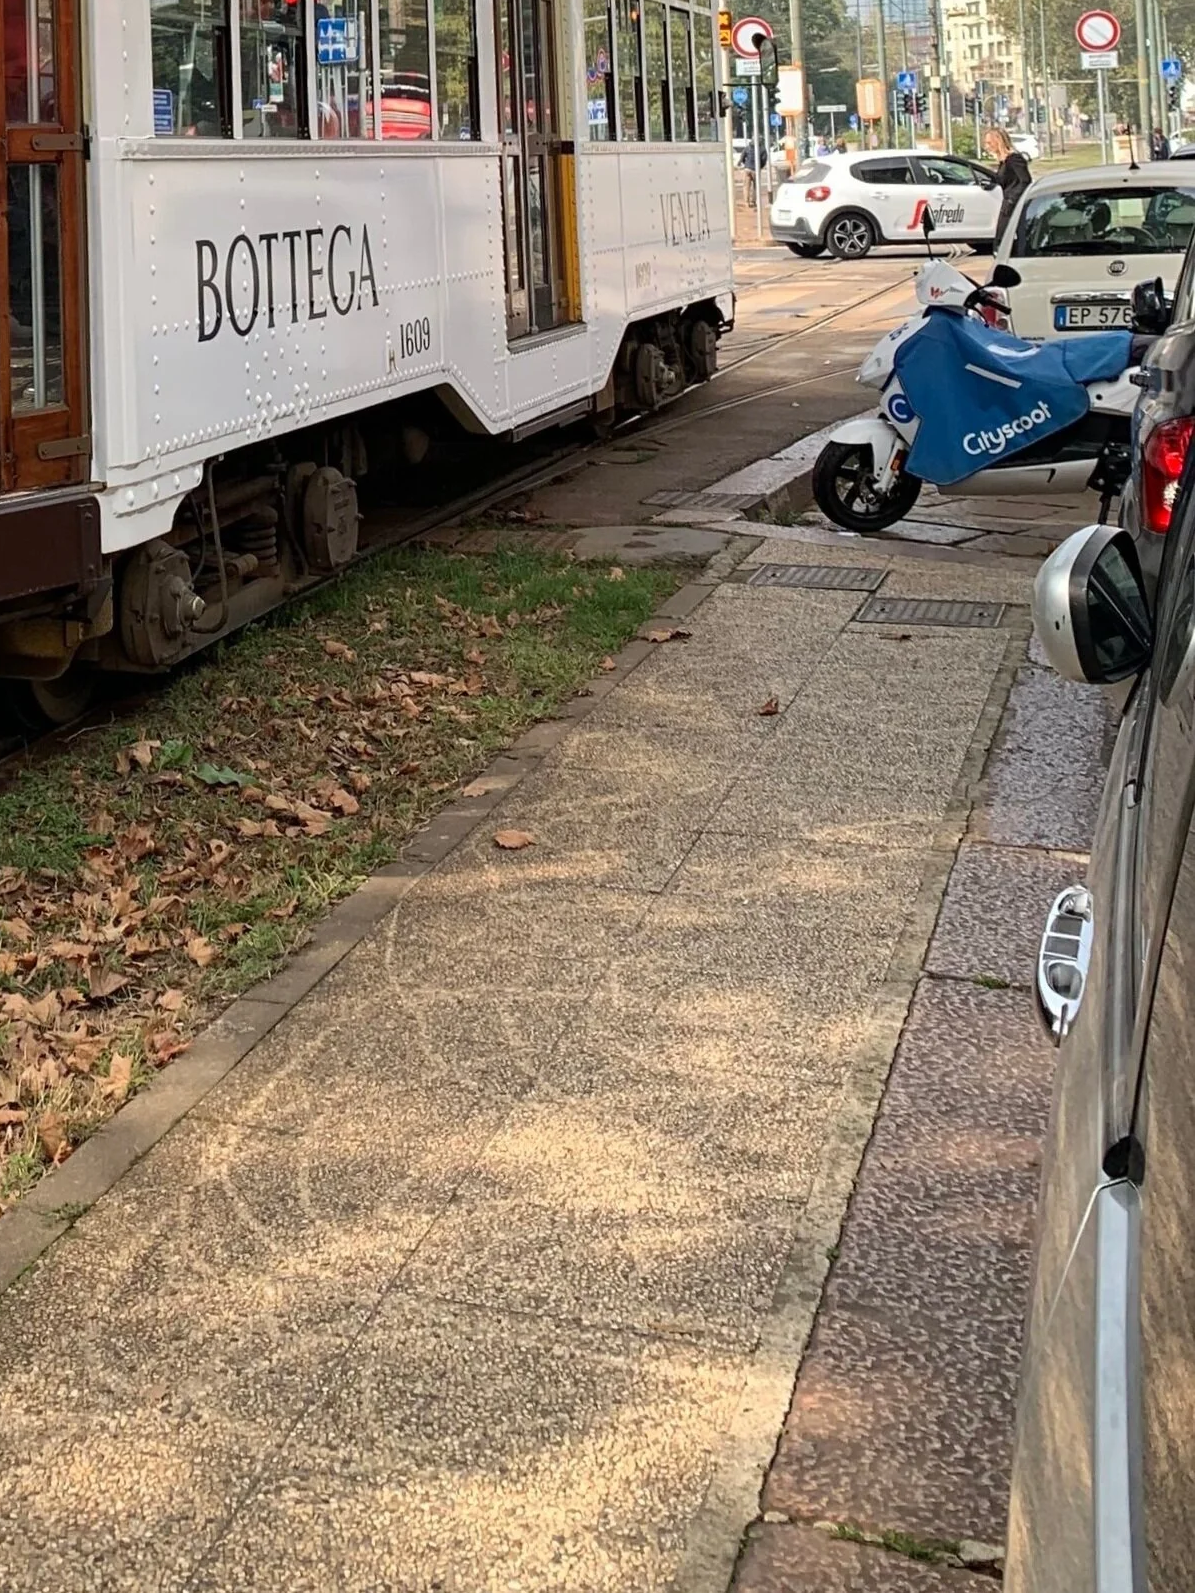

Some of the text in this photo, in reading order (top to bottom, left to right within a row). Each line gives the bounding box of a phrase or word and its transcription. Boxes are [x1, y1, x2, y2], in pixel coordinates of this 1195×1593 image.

[659, 190, 711, 247] VENETA
[195, 223, 380, 343] BOTTEGA
[399, 317, 431, 359] 1609
[1069, 307, 1091, 324] EP
[962, 400, 1053, 456] Cityscoot
